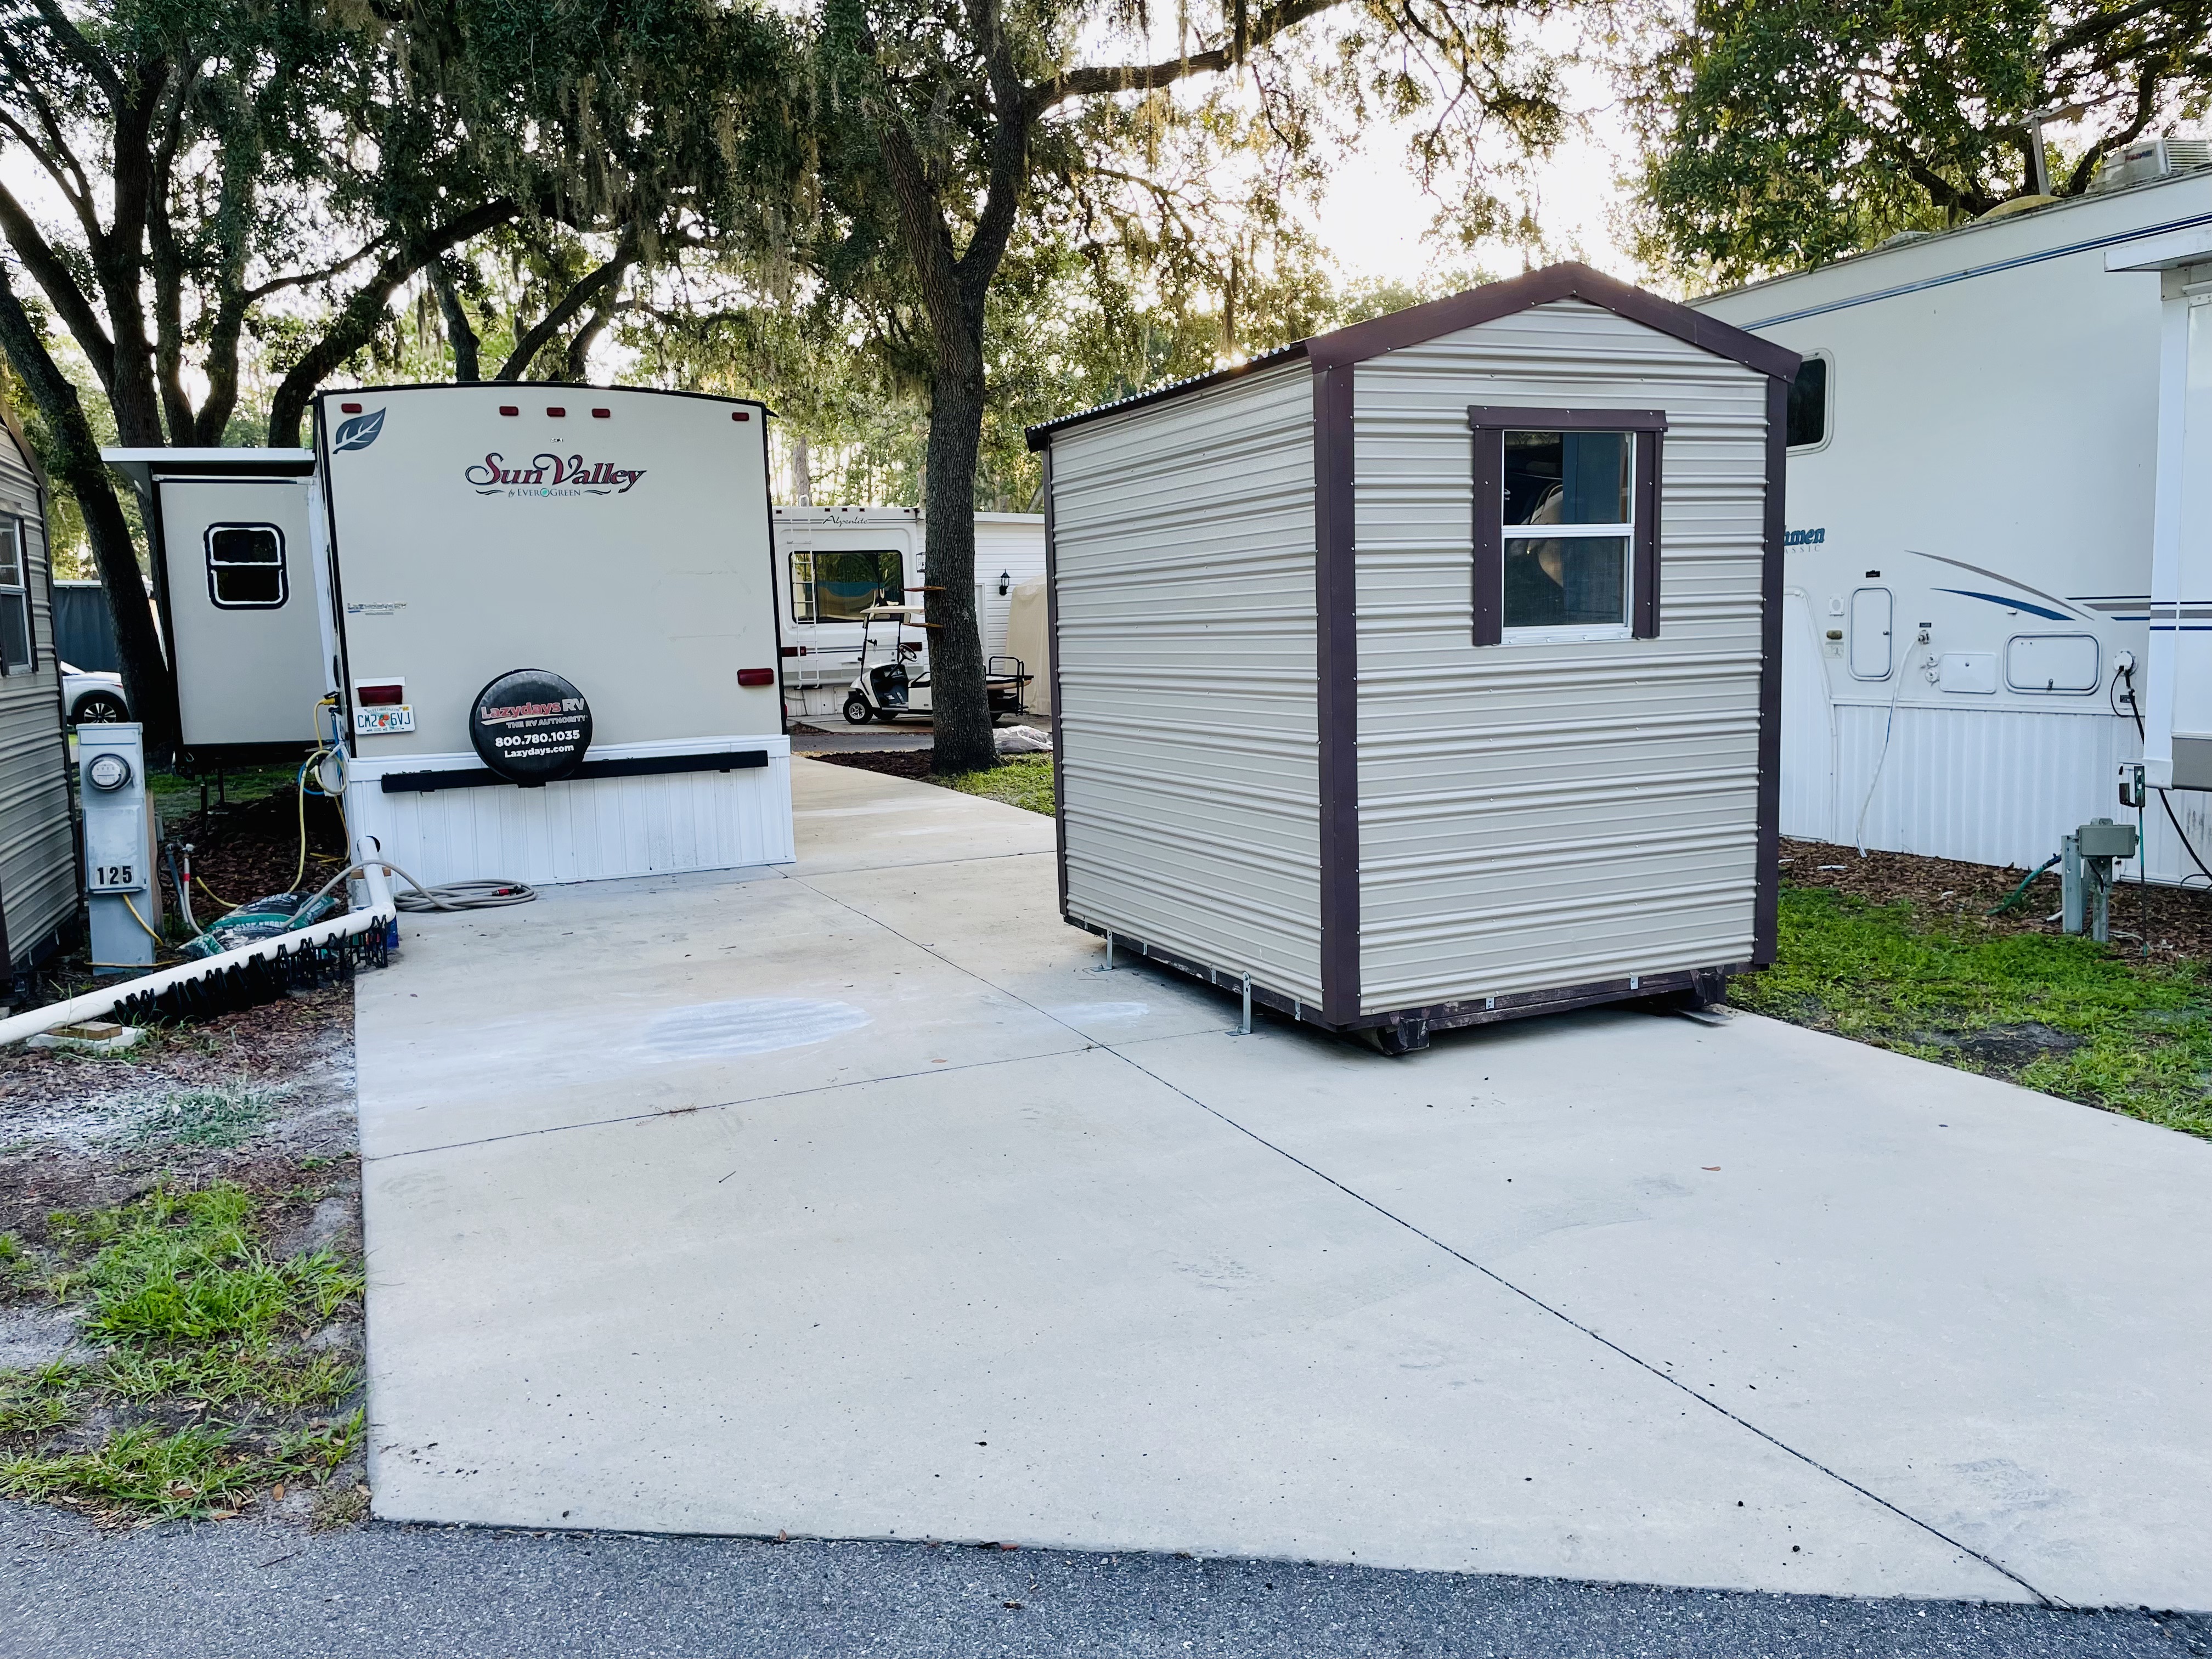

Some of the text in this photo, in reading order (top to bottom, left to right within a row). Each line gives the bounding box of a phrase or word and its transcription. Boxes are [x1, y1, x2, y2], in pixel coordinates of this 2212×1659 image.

[465, 453, 647, 493] Sun Valley
[822, 515, 867, 527] Alpenlite
[481, 698, 584, 719] Lazydays RV
[526, 719, 538, 727] RV
[538, 715, 586, 726] AUTHORITY
[495, 730, 580, 747] 800.780.1035
[504, 744, 574, 758] Lazydays.com
[97, 865, 132, 885] 125
